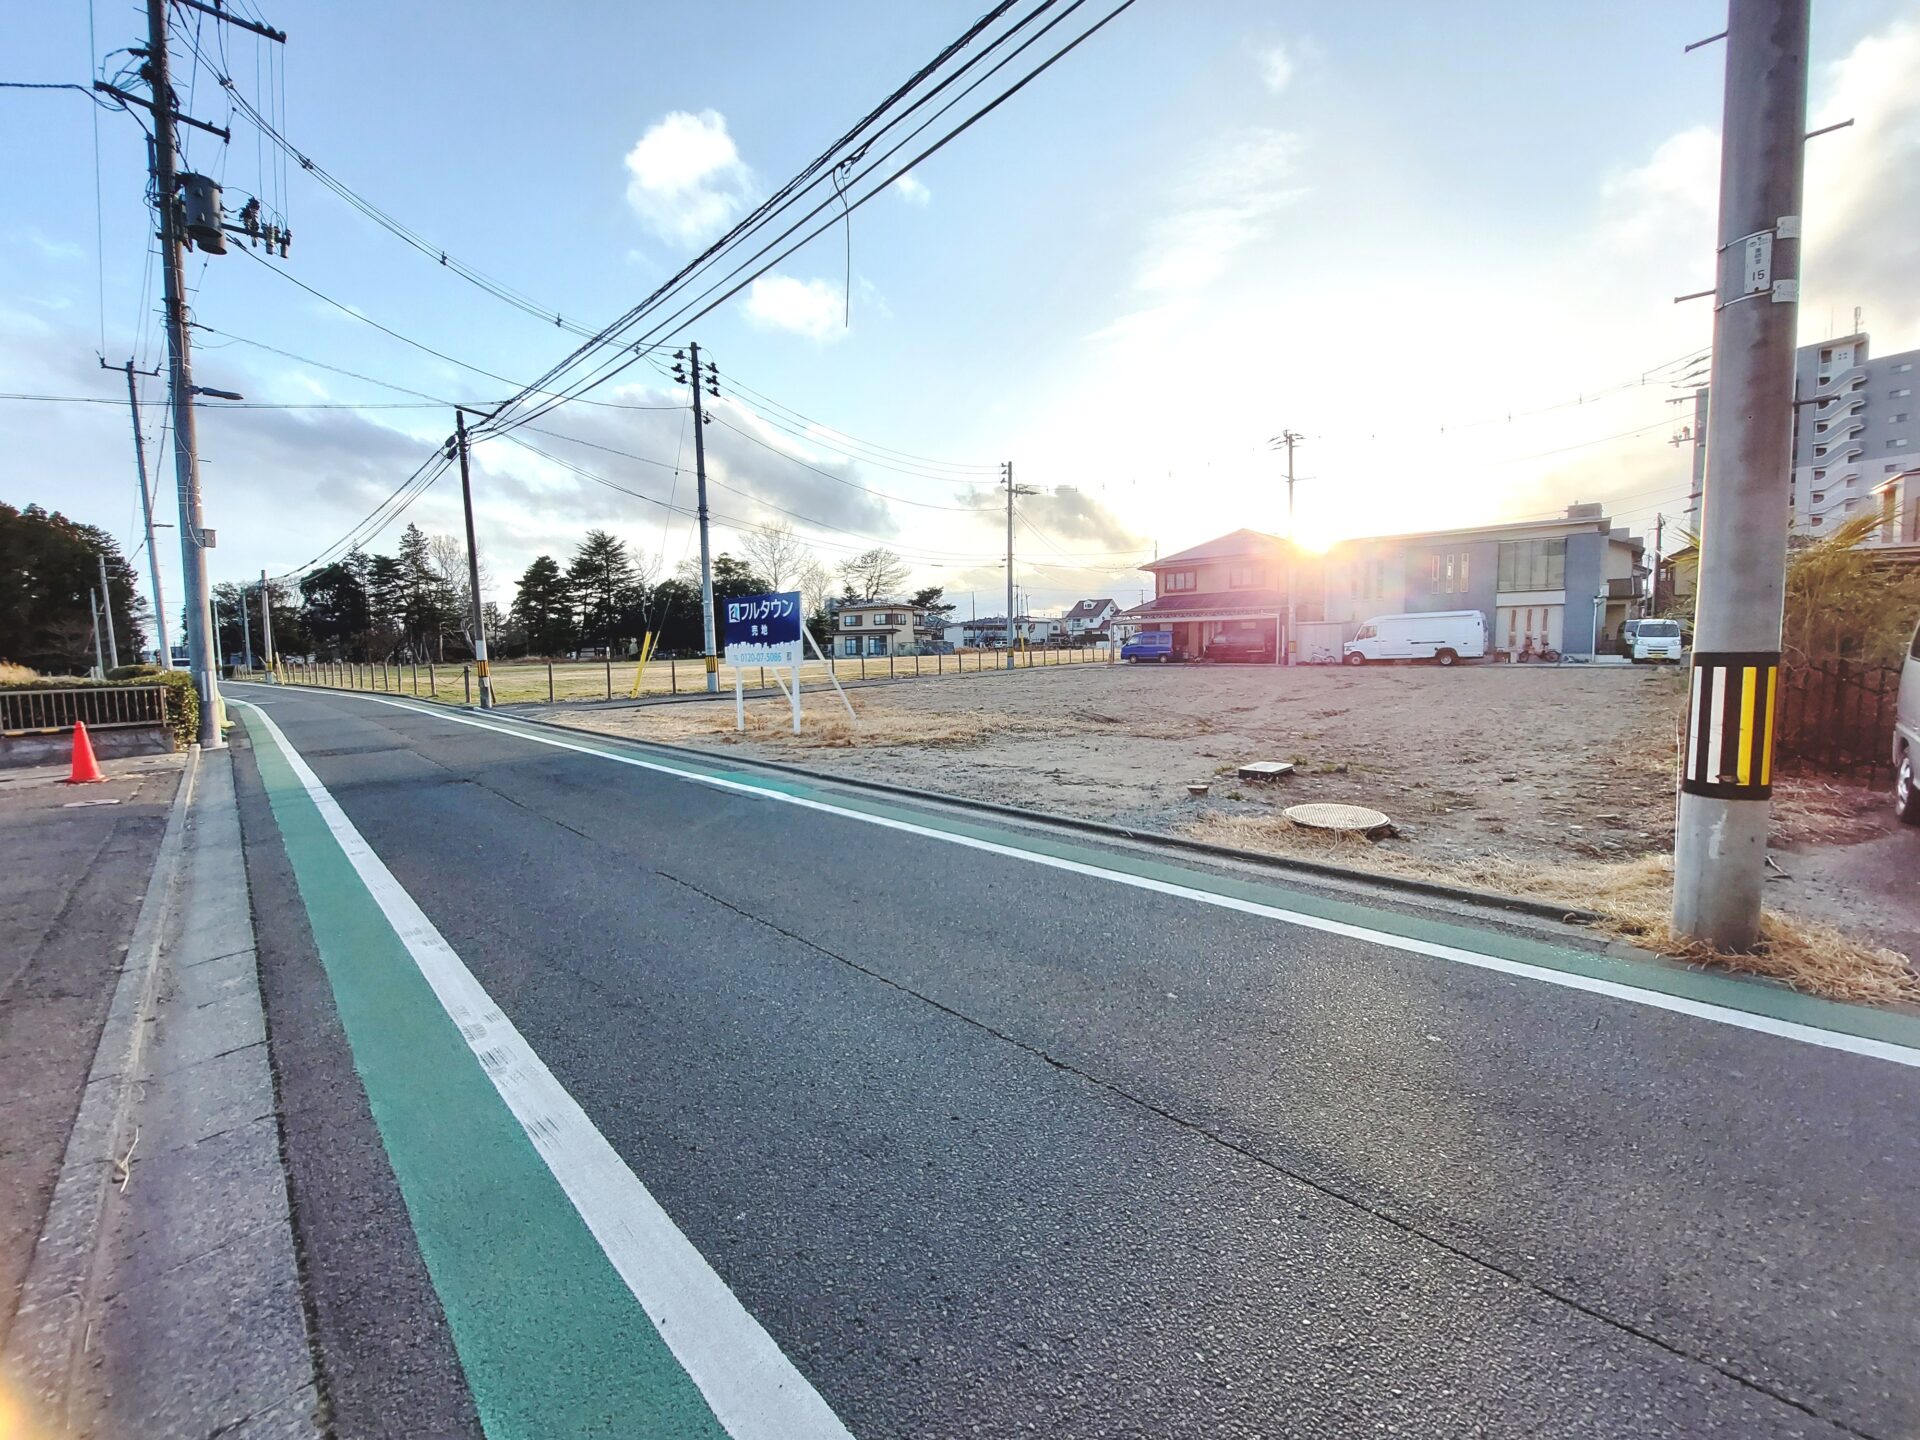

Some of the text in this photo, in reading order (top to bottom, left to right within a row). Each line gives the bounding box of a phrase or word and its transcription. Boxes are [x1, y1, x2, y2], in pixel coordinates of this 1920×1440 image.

[1752, 270, 1765, 281] 15
[740, 598, 793, 620] フルタウン
